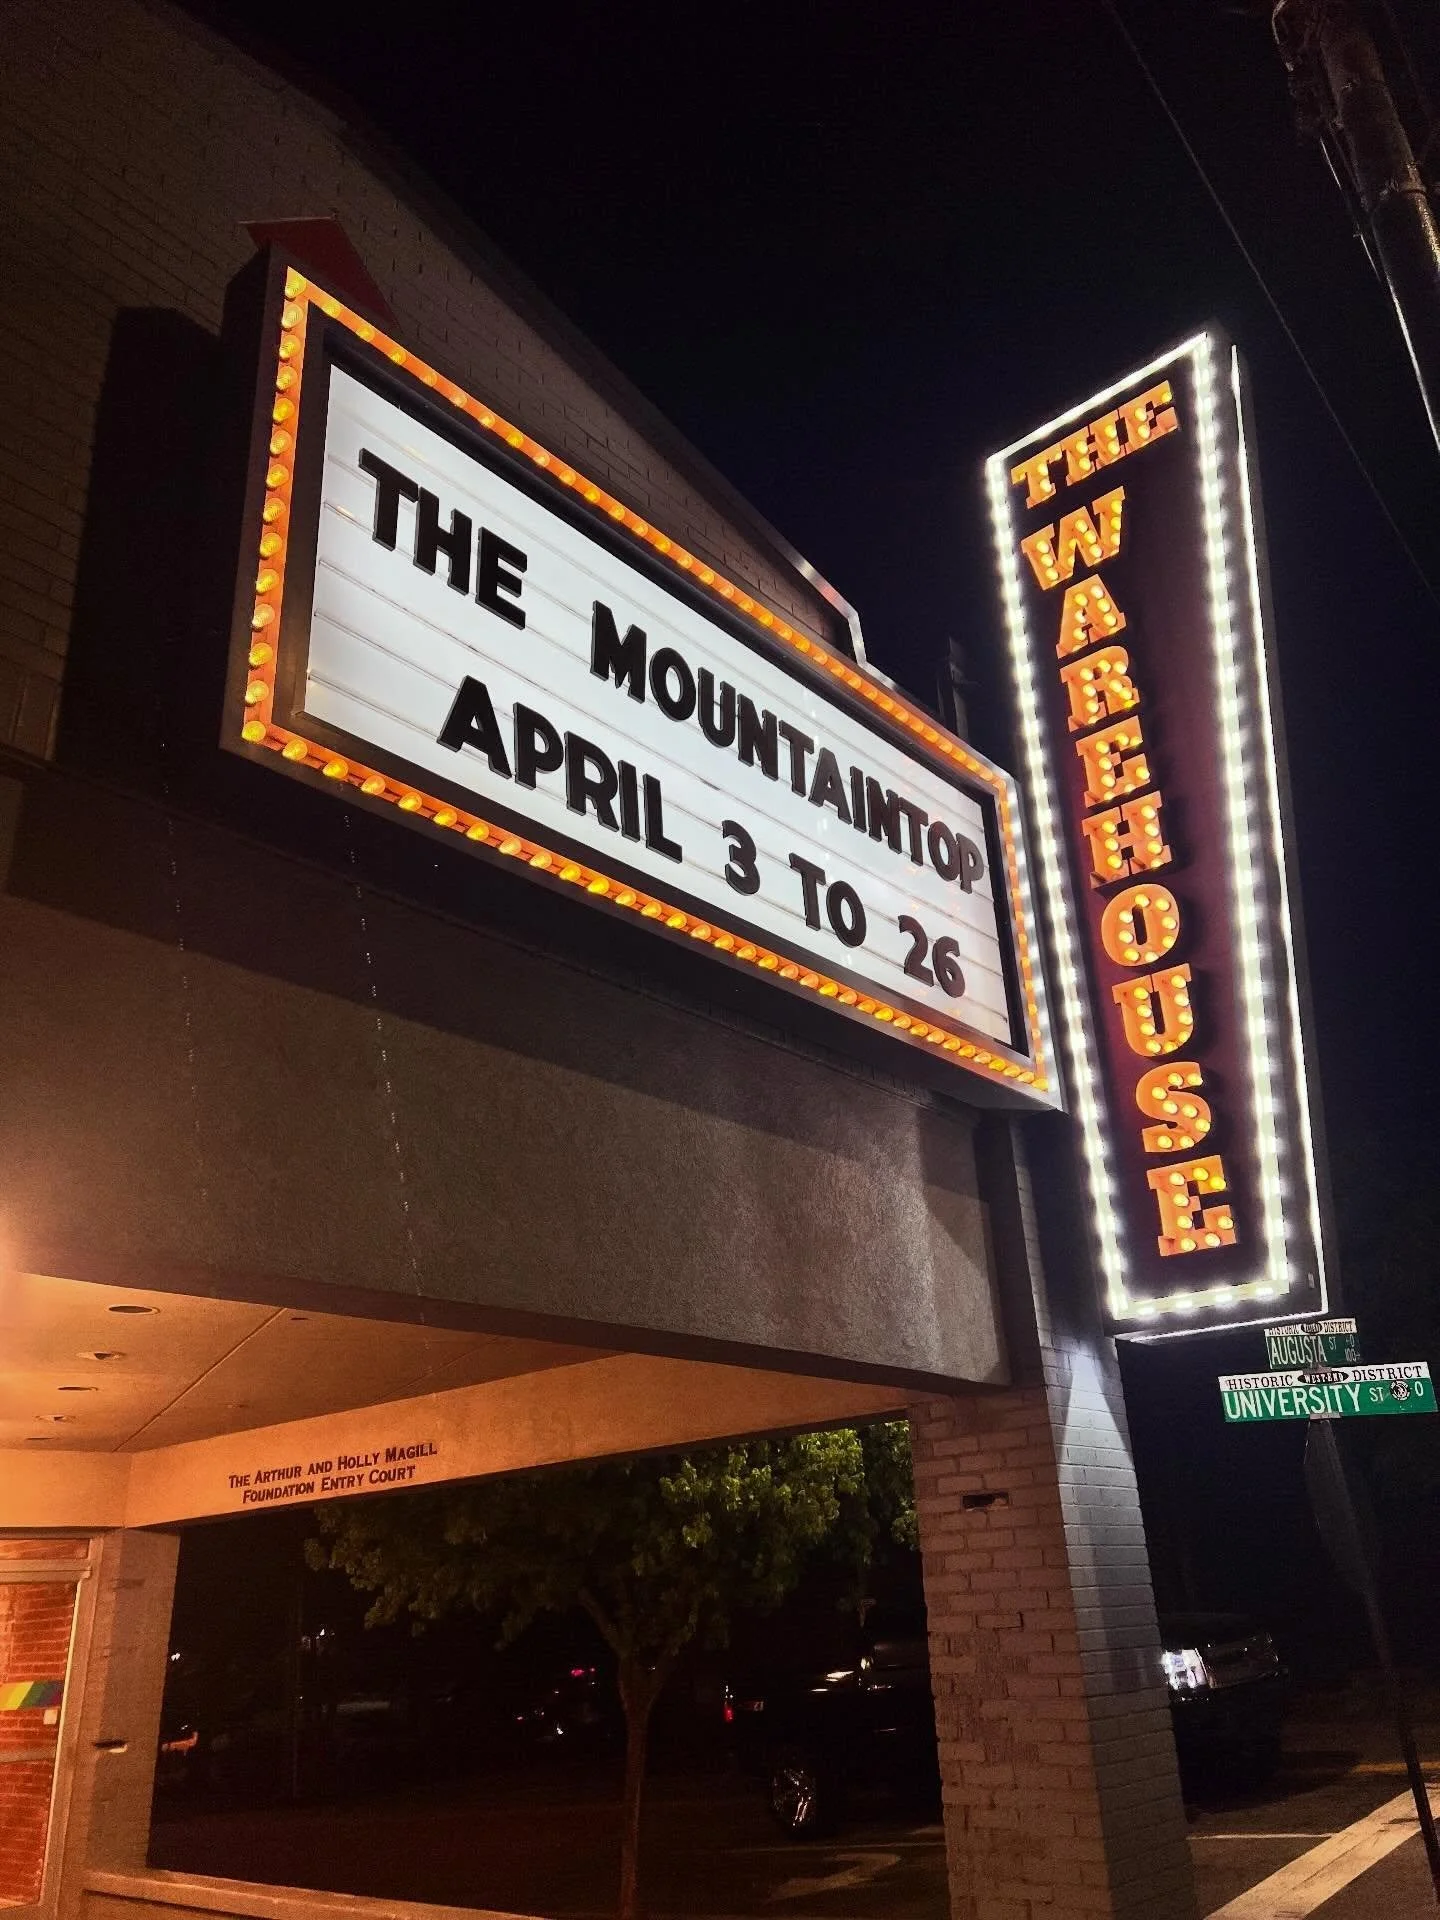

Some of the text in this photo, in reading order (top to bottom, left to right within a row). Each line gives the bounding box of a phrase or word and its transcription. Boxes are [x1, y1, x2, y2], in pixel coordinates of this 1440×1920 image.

[1011, 380, 1179, 509] THE
[358, 448, 985, 894] THE MOUNTAINTOP
[437, 675, 966, 998] APRIL 3 TO 26
[1021, 486, 1237, 1256] WAREHOUSE
[1270, 1335, 1328, 1365] AUGUSTA
[1328, 1336, 1337, 1350] ST
[1227, 1375, 1293, 1390] HISTORIC
[1352, 1365, 1422, 1382] DISTRICT
[1223, 1383, 1361, 1420] UNIVERSITY
[1369, 1387, 1385, 1402] ST
[254, 1466, 302, 1485] ARTHUR
[337, 1452, 380, 1471] HOLLY
[385, 1442, 438, 1463] MAGILL
[321, 1473, 365, 1492] ENTRY
[368, 1465, 416, 1484] COURT
